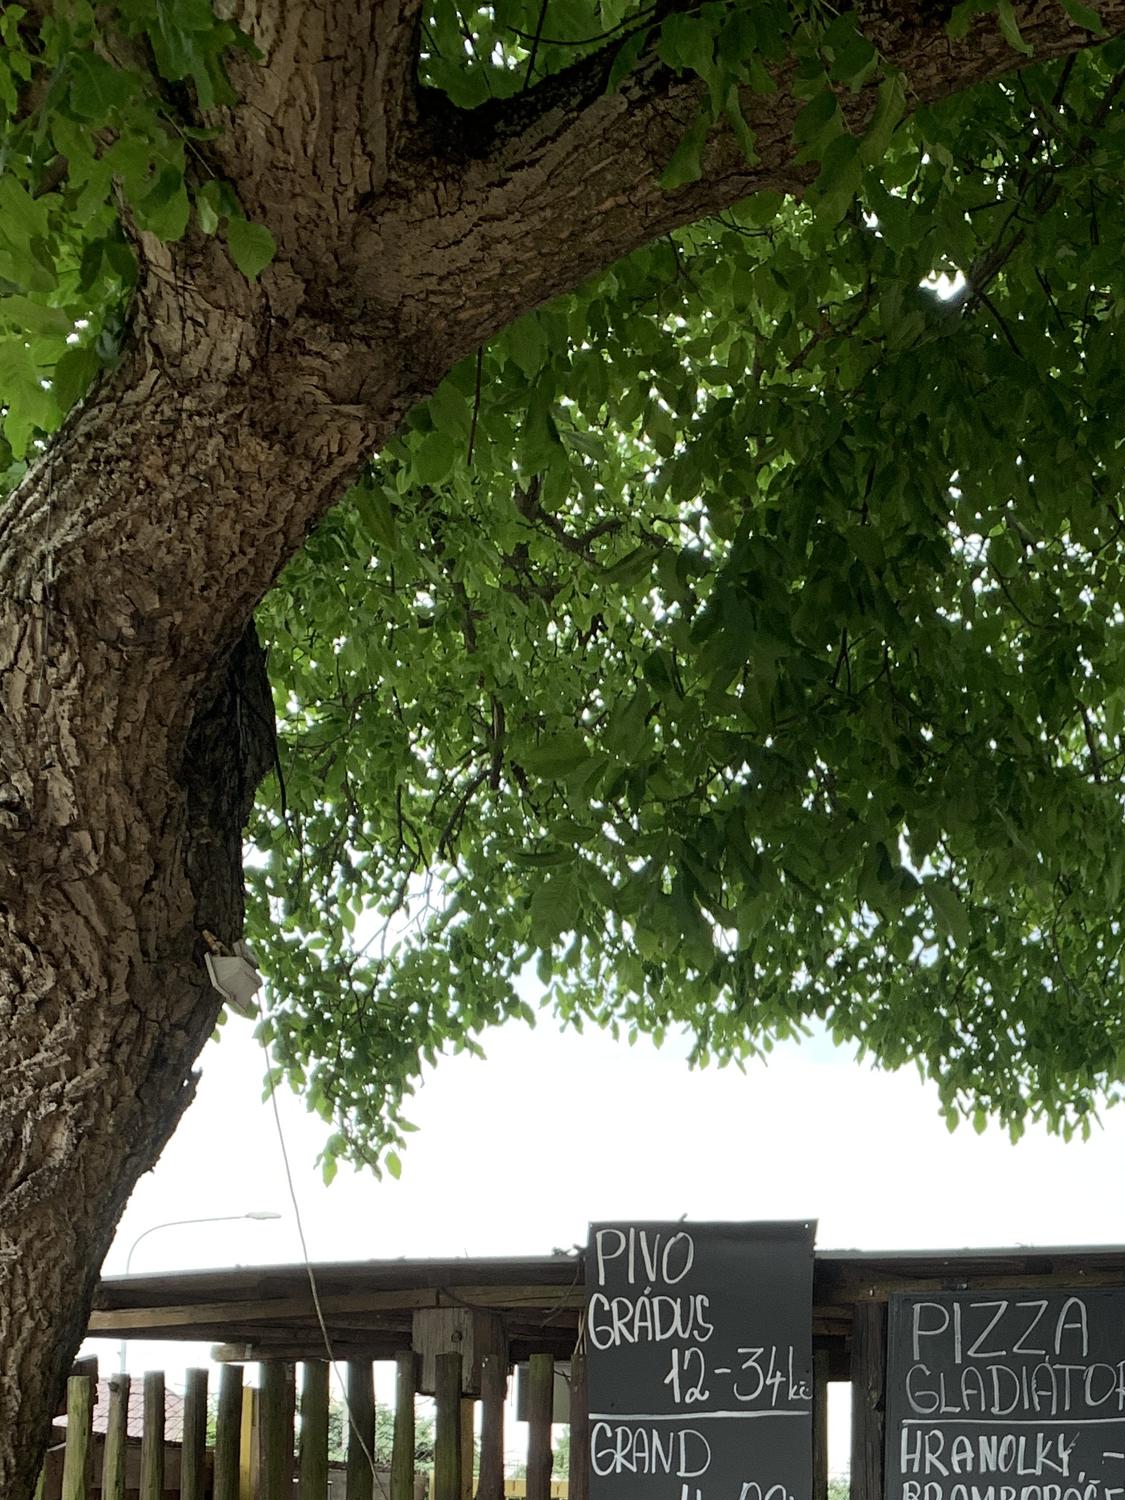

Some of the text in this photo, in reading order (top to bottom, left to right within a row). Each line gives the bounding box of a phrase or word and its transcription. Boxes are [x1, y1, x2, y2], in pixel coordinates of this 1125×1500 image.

[596, 1228, 694, 1286] PIVO
[588, 1287, 714, 1349] GRÁDUS
[912, 1297, 1088, 1364] PIZZA
[591, 1422, 711, 1477] GRAND
[901, 1427, 1080, 1477] HRANOLKY
